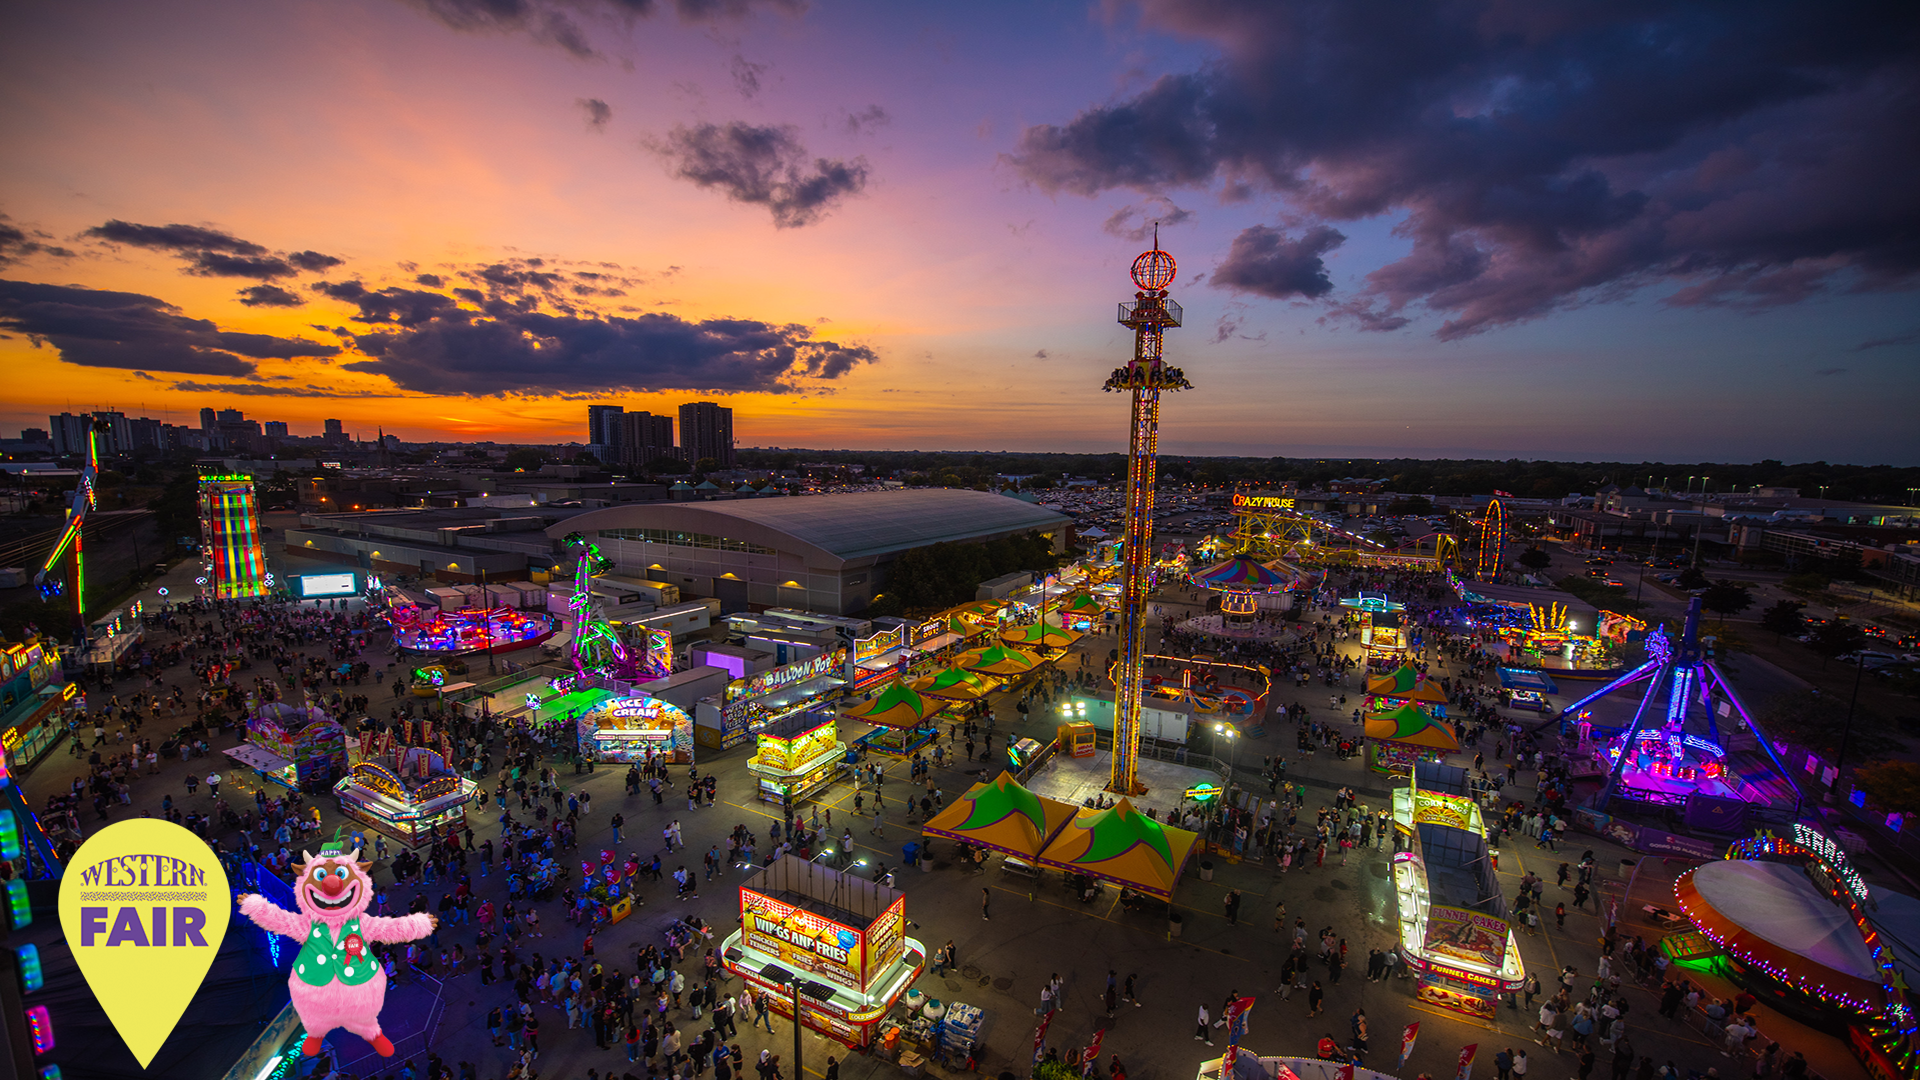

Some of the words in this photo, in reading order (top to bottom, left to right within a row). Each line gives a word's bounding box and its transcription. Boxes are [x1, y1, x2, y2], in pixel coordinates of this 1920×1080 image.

[1232, 493, 1264, 507] CRAZY
[765, 661, 811, 686] BALLOON
[814, 656, 832, 673] POP
[620, 699, 643, 708] ICE
[613, 708, 659, 718] CREAM
[791, 734, 814, 754] CORN
[815, 727, 834, 738] DOGS
[419, 783, 454, 799] PIZZA
[1431, 907, 1469, 922] FUNNEL
[1472, 914, 1507, 934] CAKES
[749, 933, 779, 948] CHICKEN
[750, 939, 780, 957] TENDERS
[876, 933, 898, 959] FRIES
[792, 952, 813, 967] FRIES
[815, 941, 847, 963] FRIES
[735, 965, 758, 980] CHICKEN
[823, 962, 857, 979] CHICKEN
[1431, 965, 1465, 978] FUNNEL
[1467, 973, 1497, 986] CAKES
[826, 972, 854, 987] WINGS
[814, 998, 843, 1016] TENDERS
